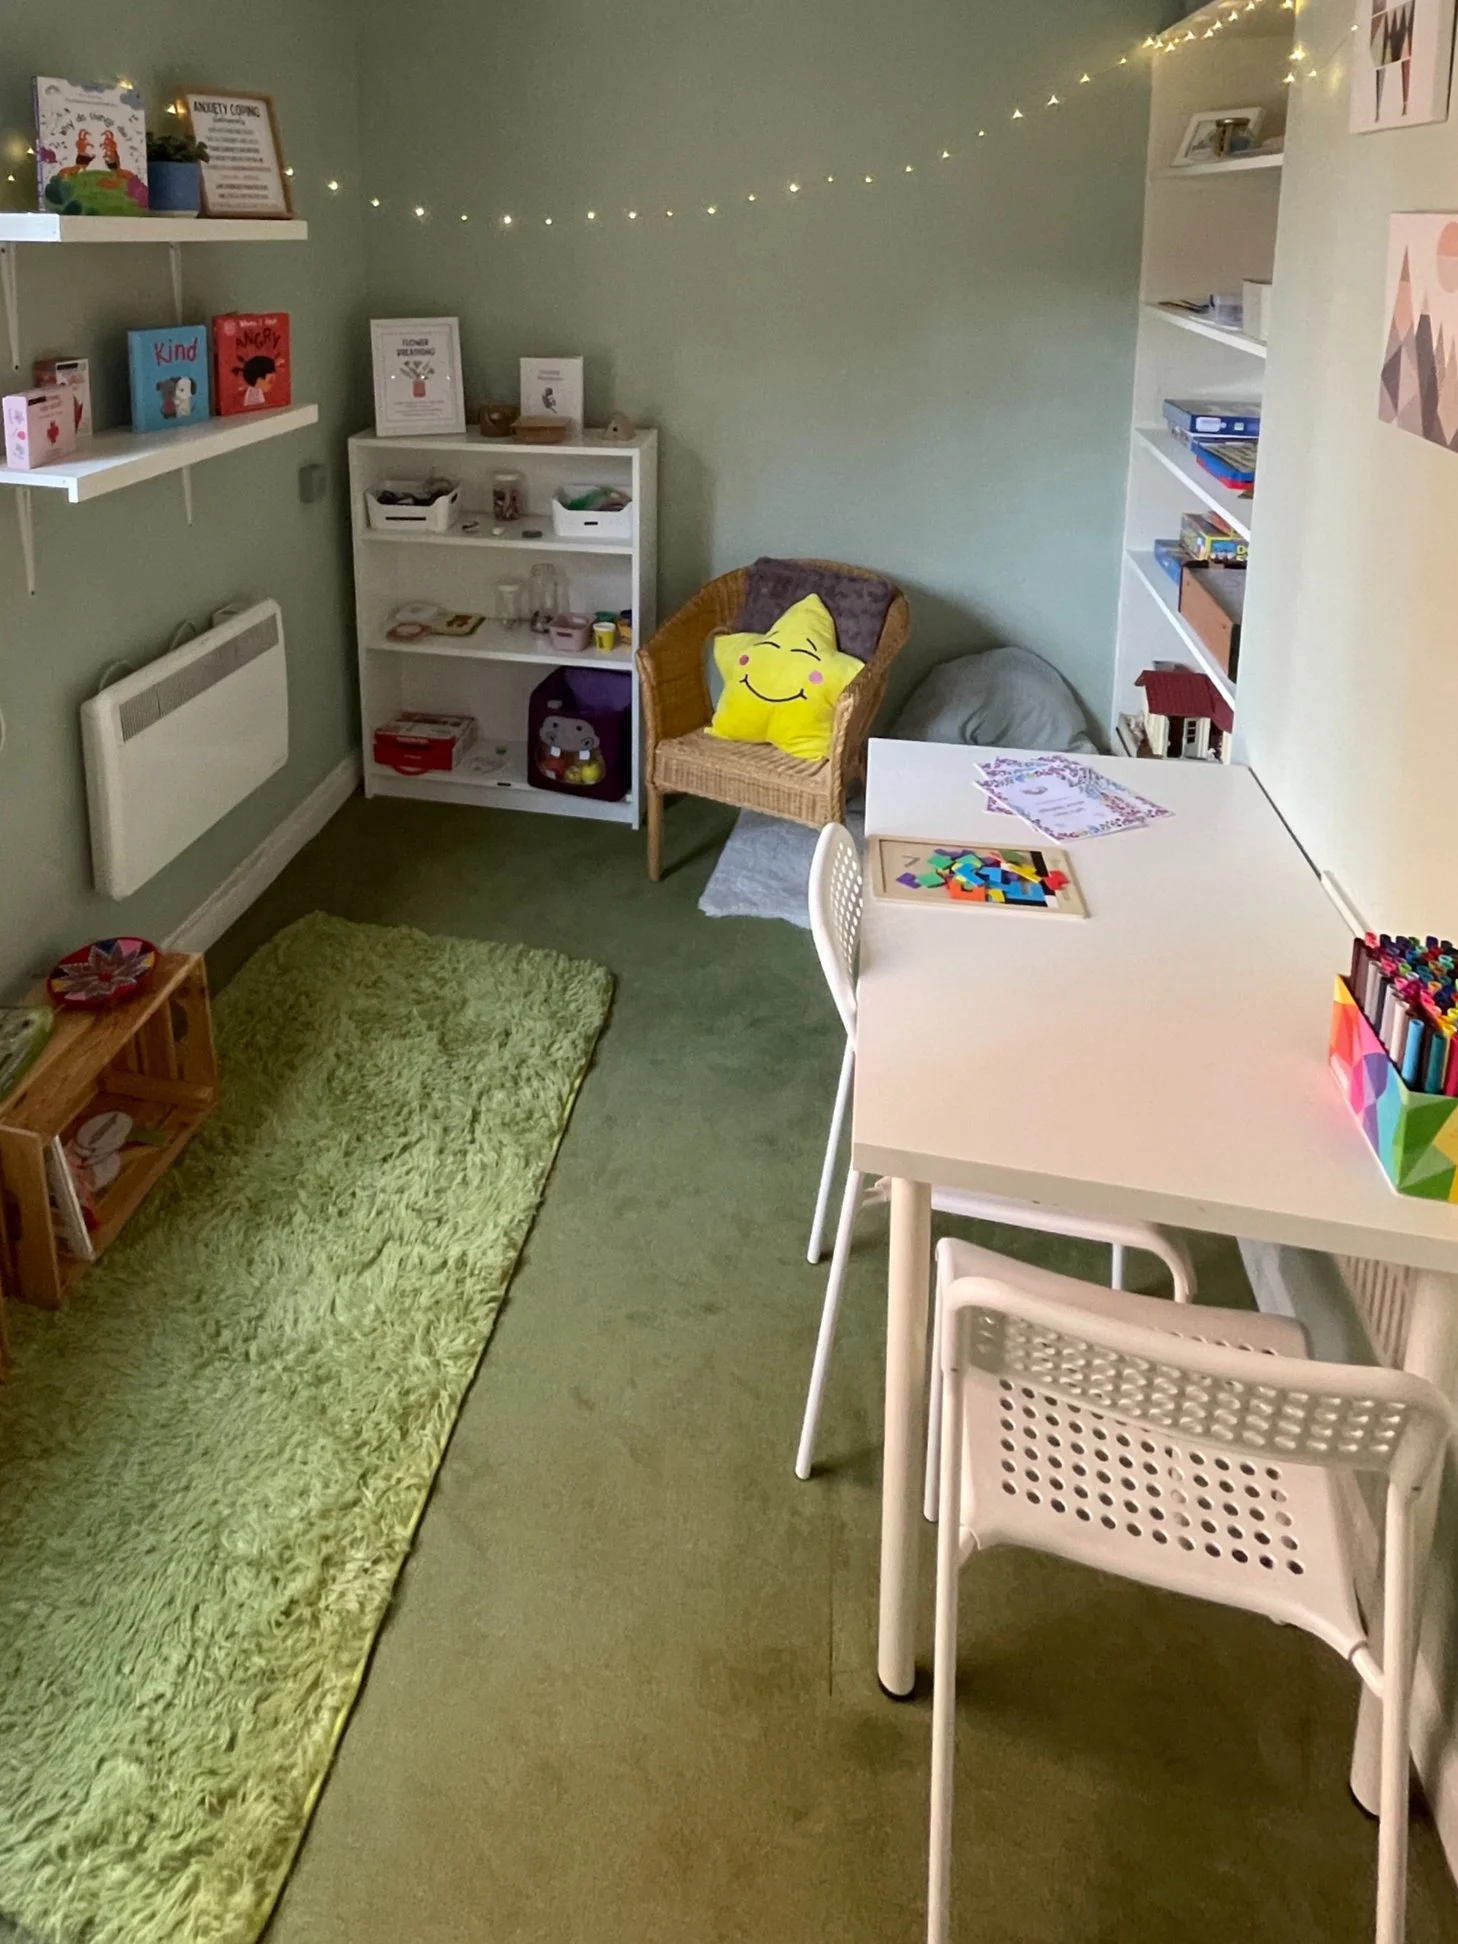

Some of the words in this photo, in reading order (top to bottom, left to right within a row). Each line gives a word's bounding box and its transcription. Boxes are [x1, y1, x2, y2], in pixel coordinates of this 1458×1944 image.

[193, 101, 228, 116] ANXIETY
[230, 104, 261, 118] COPING
[235, 327, 282, 349] ANGRY
[402, 338, 429, 347] FLOWER
[154, 336, 198, 366] Kind
